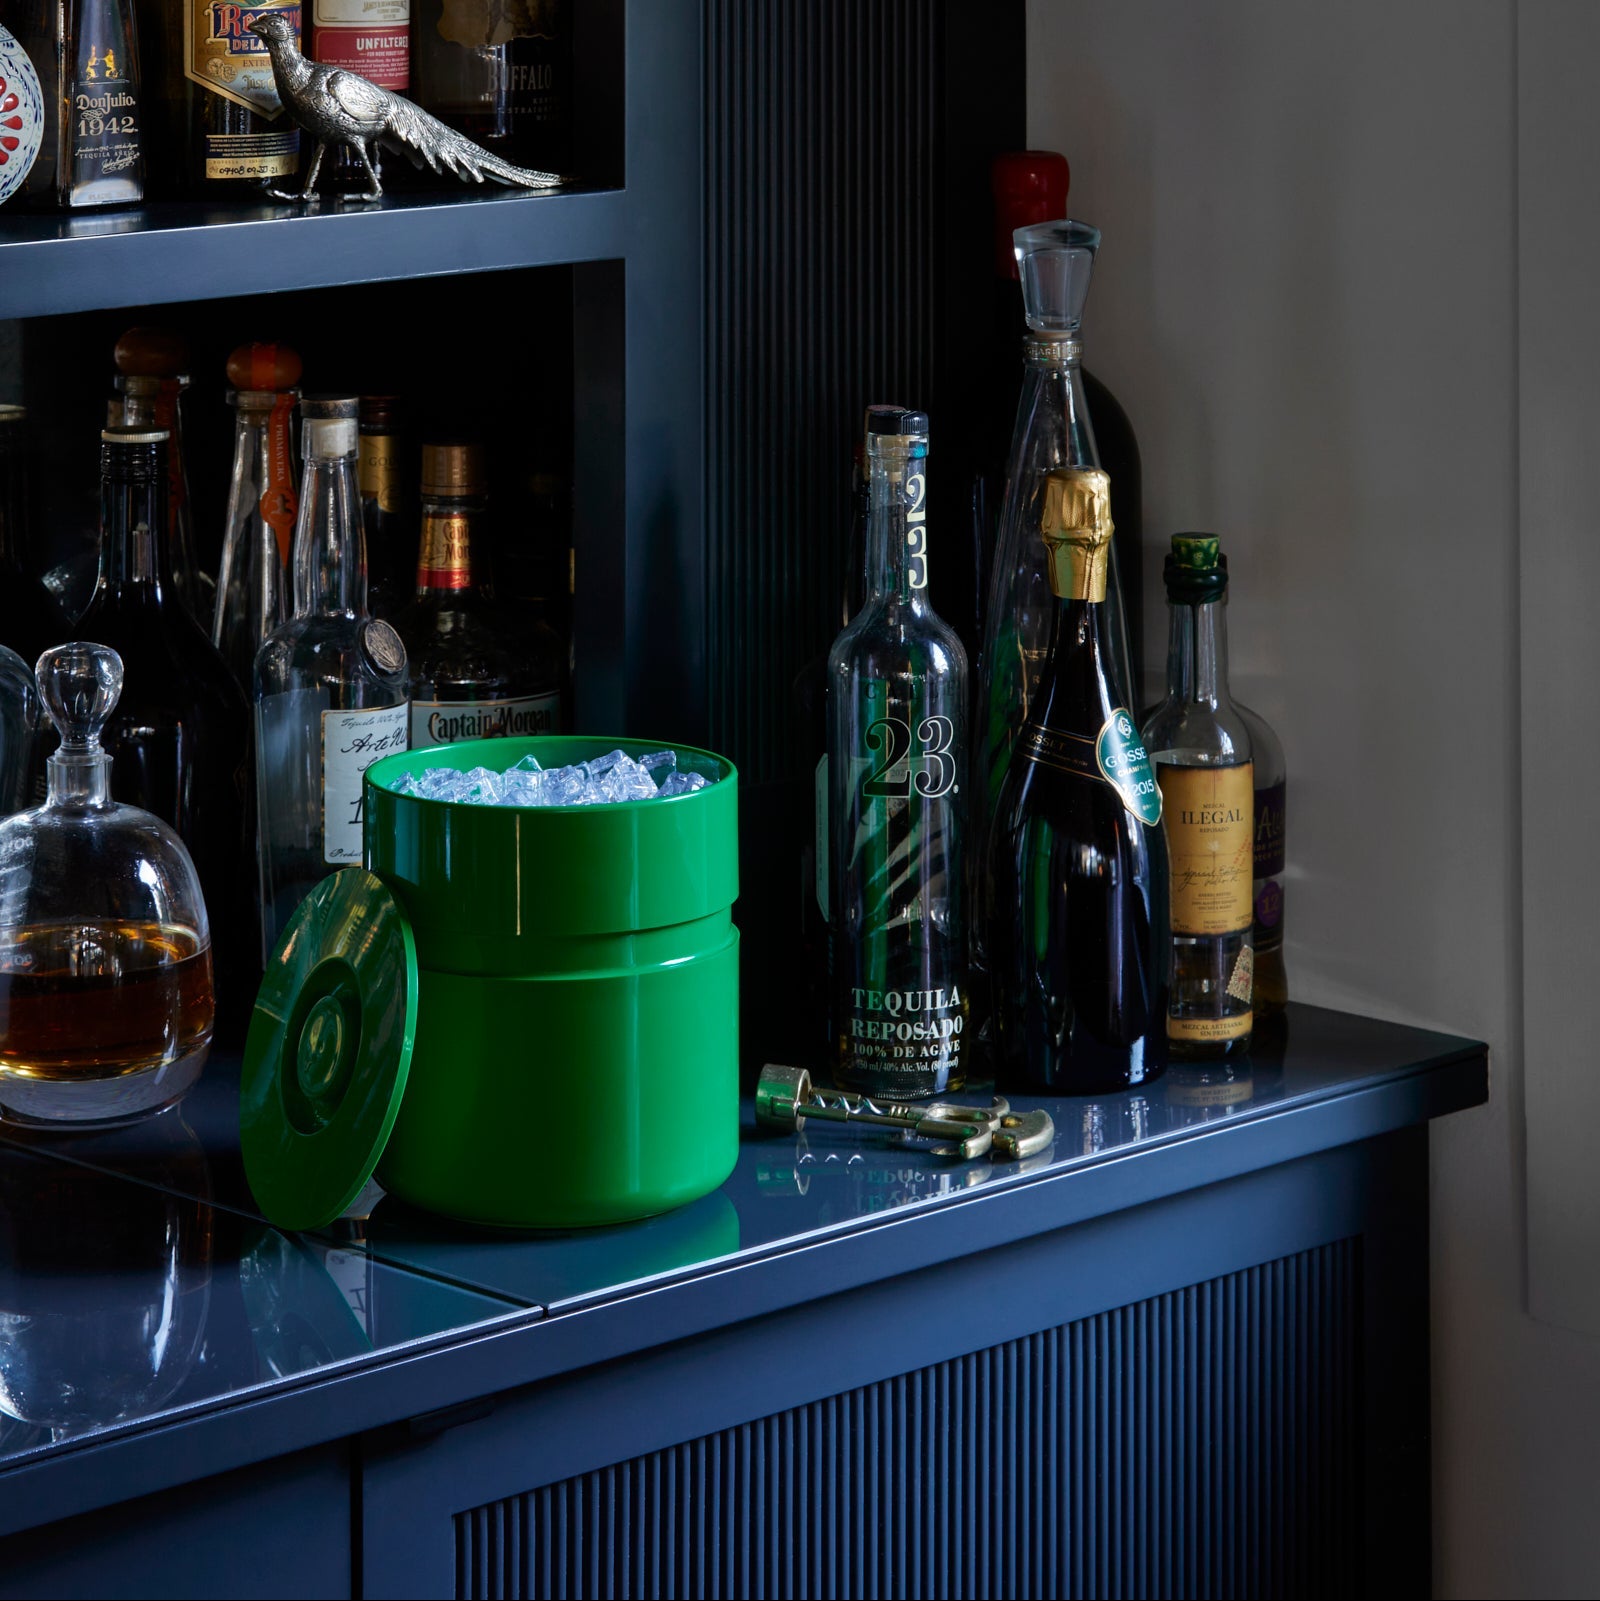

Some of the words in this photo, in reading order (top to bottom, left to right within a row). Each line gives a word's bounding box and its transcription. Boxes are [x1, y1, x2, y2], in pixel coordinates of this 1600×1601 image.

[232, 39, 248, 50] DE
[250, 38, 264, 50] LA
[79, 152, 111, 160] TEQUILA
[427, 709, 492, 744] Captain
[492, 706, 550, 737] Morgan
[1182, 808, 1244, 825] ILEGAL
[851, 985, 961, 1018] TEQUILA
[850, 1015, 963, 1041] REPOSADO
[1182, 1022, 1209, 1031] MEZCAL
[853, 1042, 887, 1058] 100%
[893, 1046, 914, 1058] DE
[919, 1039, 961, 1058] AGAVE
[916, 1061, 930, 1072] Vol.
